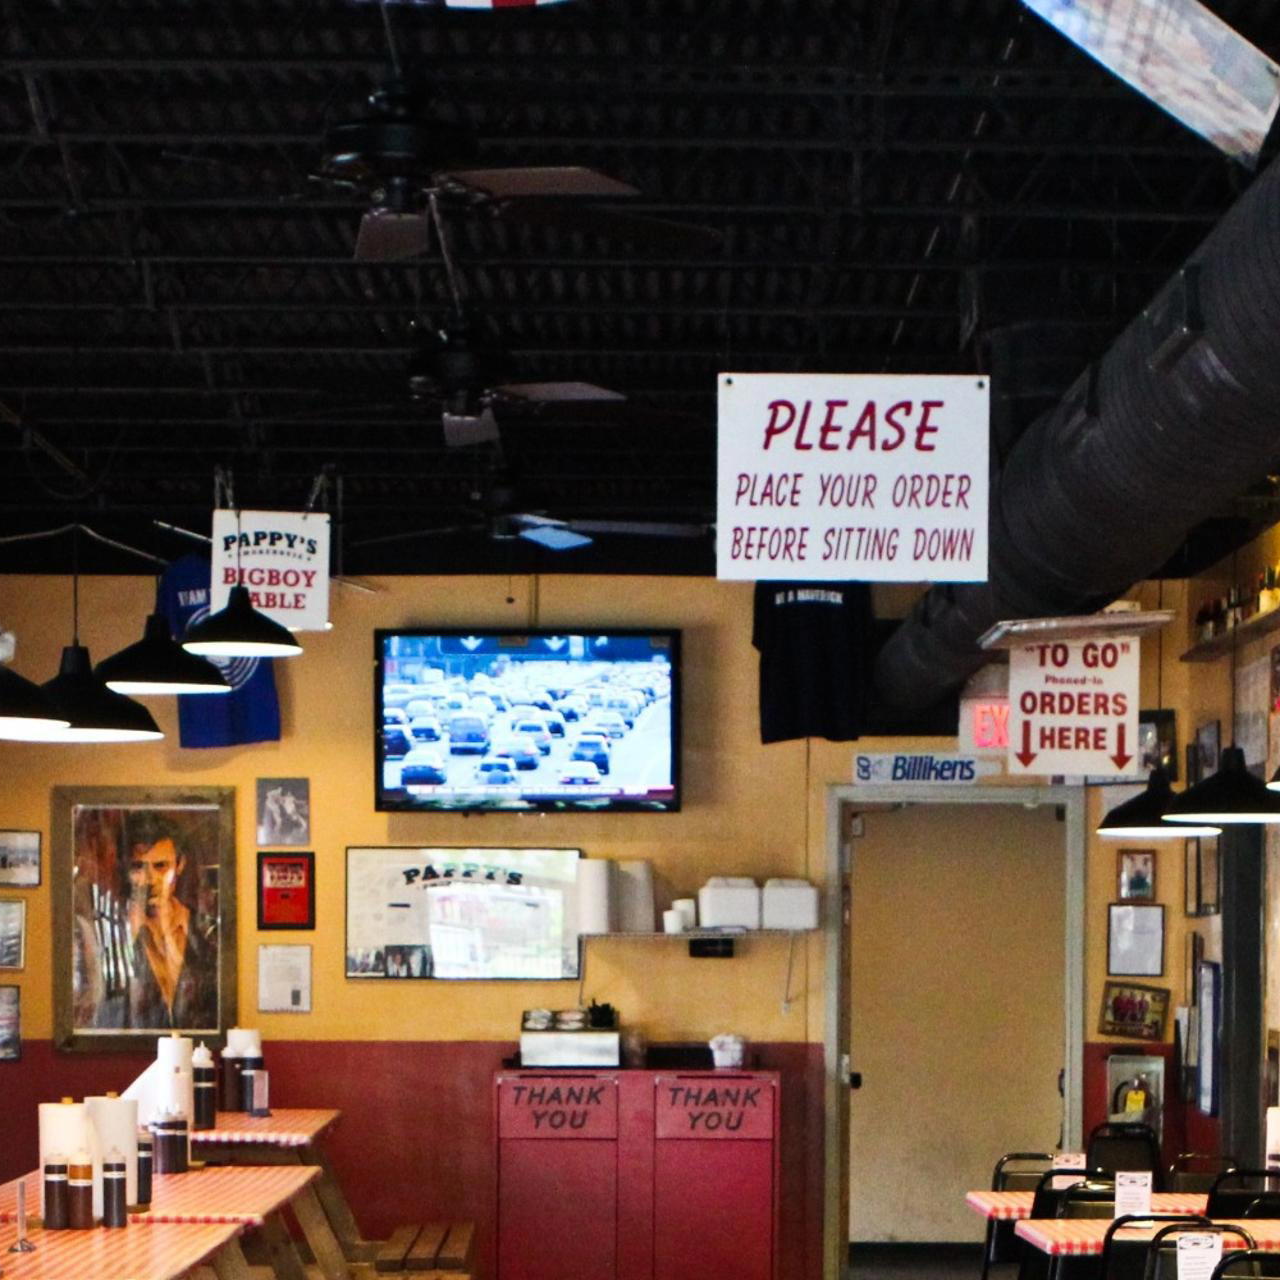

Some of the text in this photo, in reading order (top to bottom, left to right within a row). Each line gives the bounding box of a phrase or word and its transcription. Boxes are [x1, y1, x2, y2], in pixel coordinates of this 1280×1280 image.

[763, 400, 944, 451] PLEASE
[735, 472, 971, 510] PLACE YOUR ORDER
[223, 531, 318, 555] PAPPY'S
[731, 526, 975, 562] BEFORE SITTING DOWN
[223, 567, 317, 588] BIGBOY
[249, 591, 307, 610] ABLE
[1020, 691, 1128, 716] ORDERS
[974, 703, 1010, 749] EX
[1040, 726, 1107, 751] HERE
[891, 755, 975, 781] Billikens
[512, 1085, 606, 1106] THANK
[669, 1086, 762, 1108] THANK
[531, 1110, 588, 1130] YOU
[687, 1111, 744, 1131] YOU
